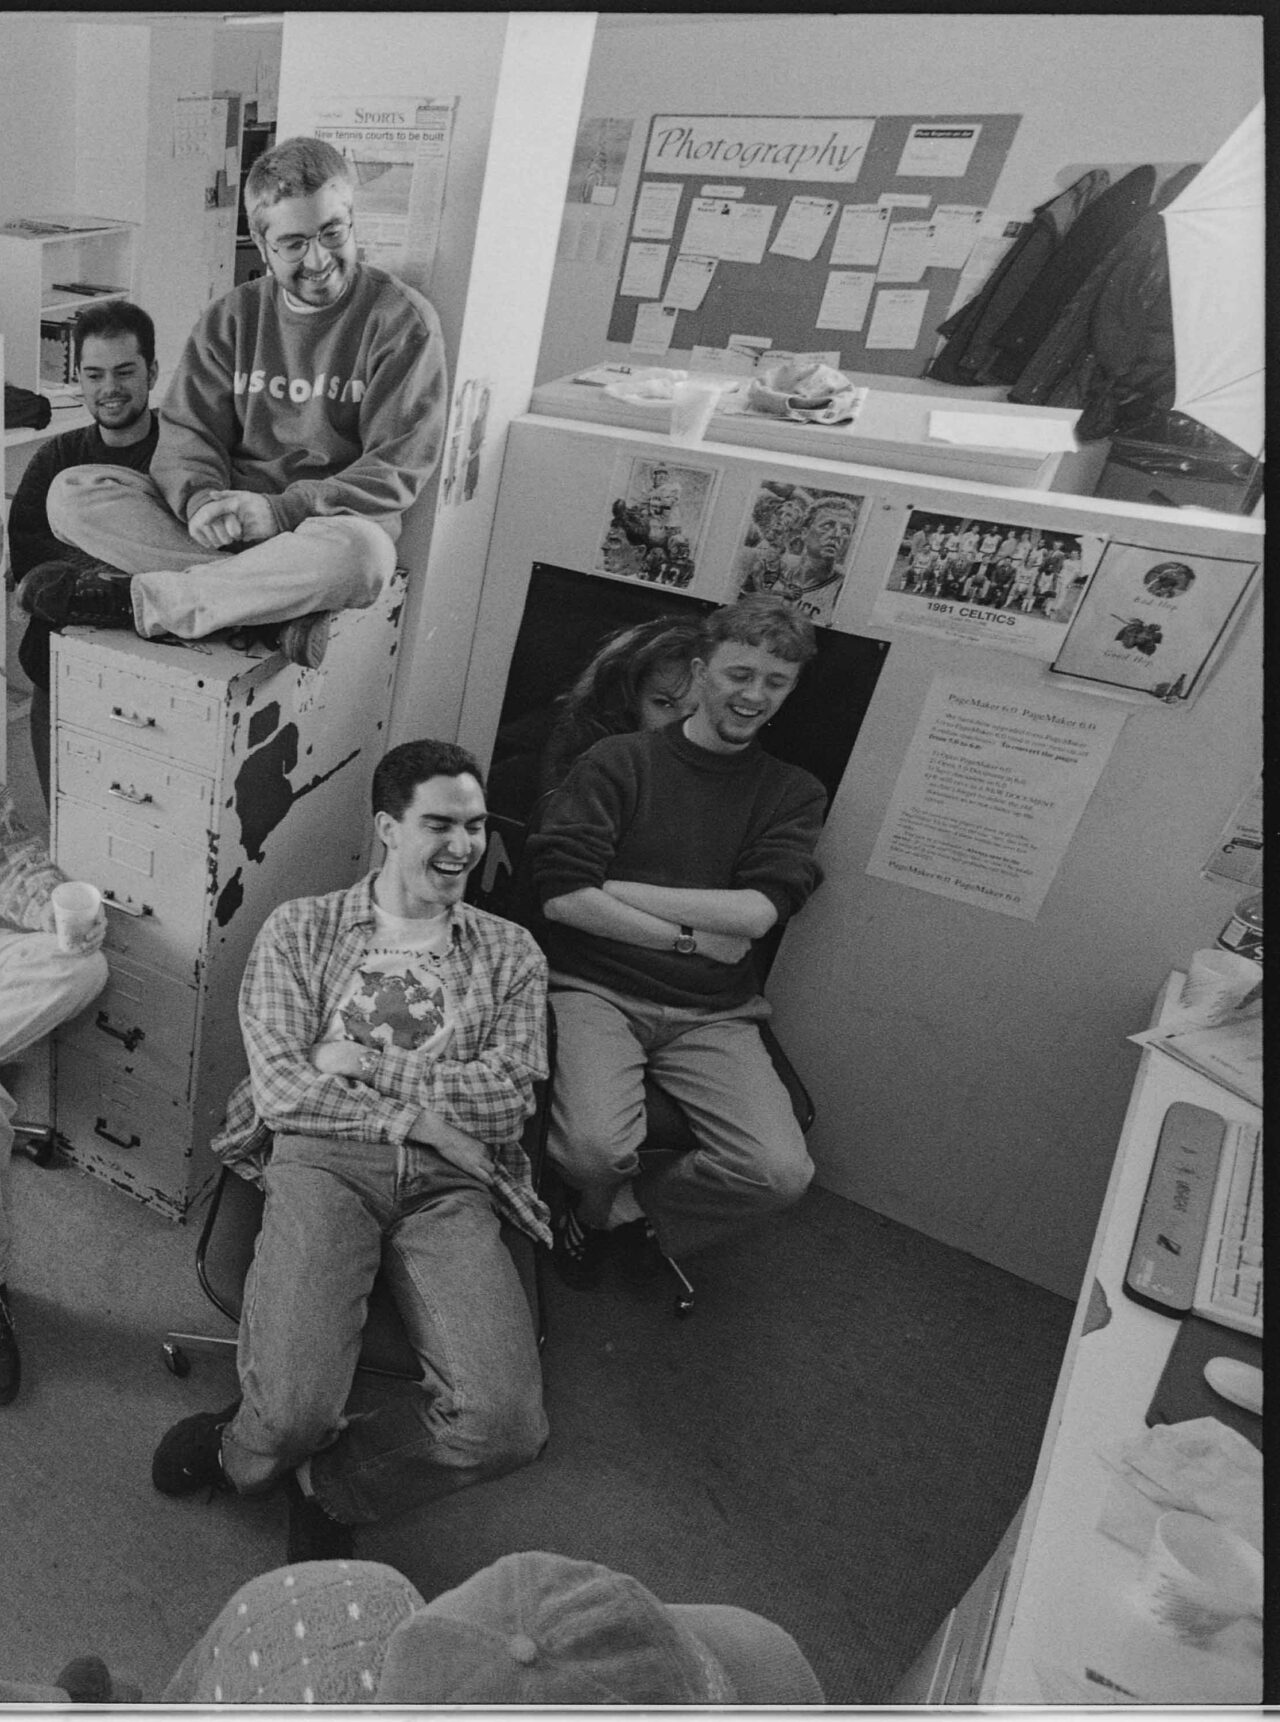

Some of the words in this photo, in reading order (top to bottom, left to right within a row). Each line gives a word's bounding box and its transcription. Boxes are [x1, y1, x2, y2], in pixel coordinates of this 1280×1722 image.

[353, 107, 405, 124] SPORTS
[315, 130, 333, 139] New
[335, 130, 363, 140] tennis
[365, 131, 394, 141] courts
[396, 131, 406, 140] to
[408, 132, 420, 141] be
[422, 132, 445, 142] built
[658, 127, 863, 173] Photography
[927, 602, 953, 614] 1981
[959, 607, 1016, 626] CELTICS
[948, 693, 1000, 713] PageMaker
[1022, 708, 1077, 728] PageMaker
